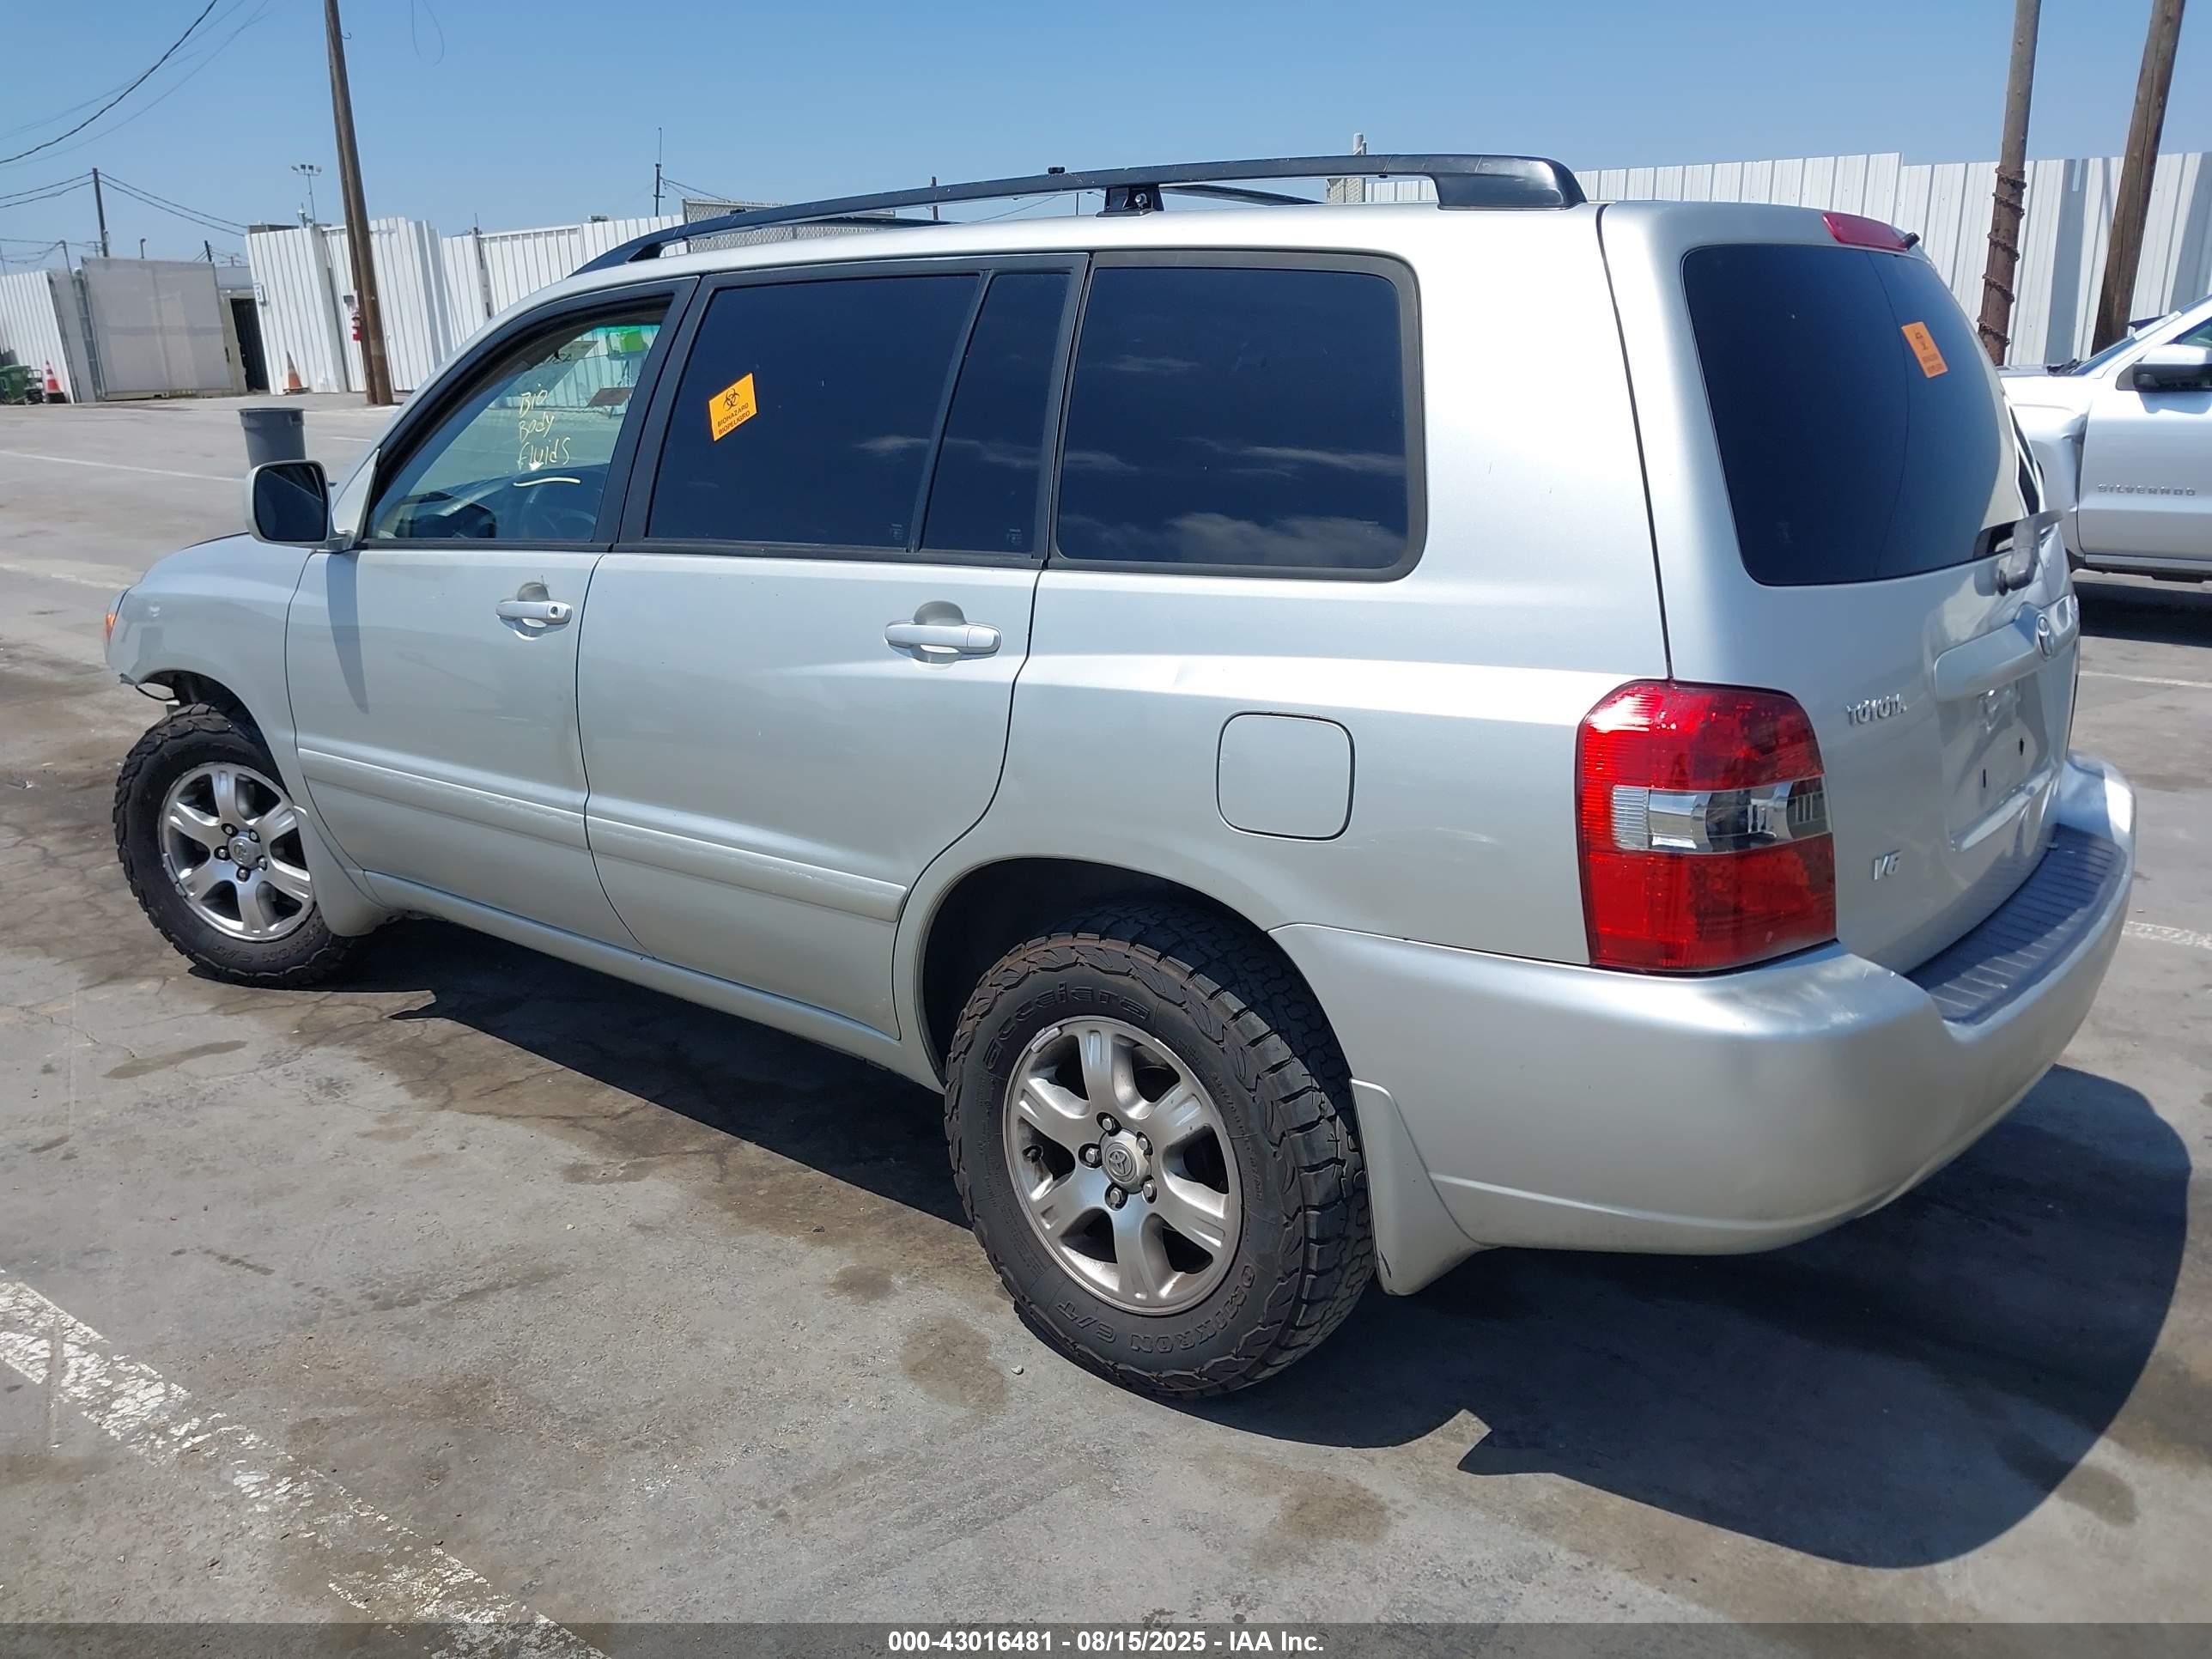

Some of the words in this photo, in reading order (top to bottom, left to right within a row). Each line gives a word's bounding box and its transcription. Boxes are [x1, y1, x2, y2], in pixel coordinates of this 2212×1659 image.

[519, 411, 556, 442] Body
[718, 402, 750, 428] BIOHAZARD
[719, 410, 751, 435] BIOPELIGRO
[2097, 483, 2197, 496] SILVERADO
[1845, 693, 1908, 727] TOYOTA
[1872, 850, 1901, 881] V6
[1129, 1264, 1256, 1354] OMIKRON
